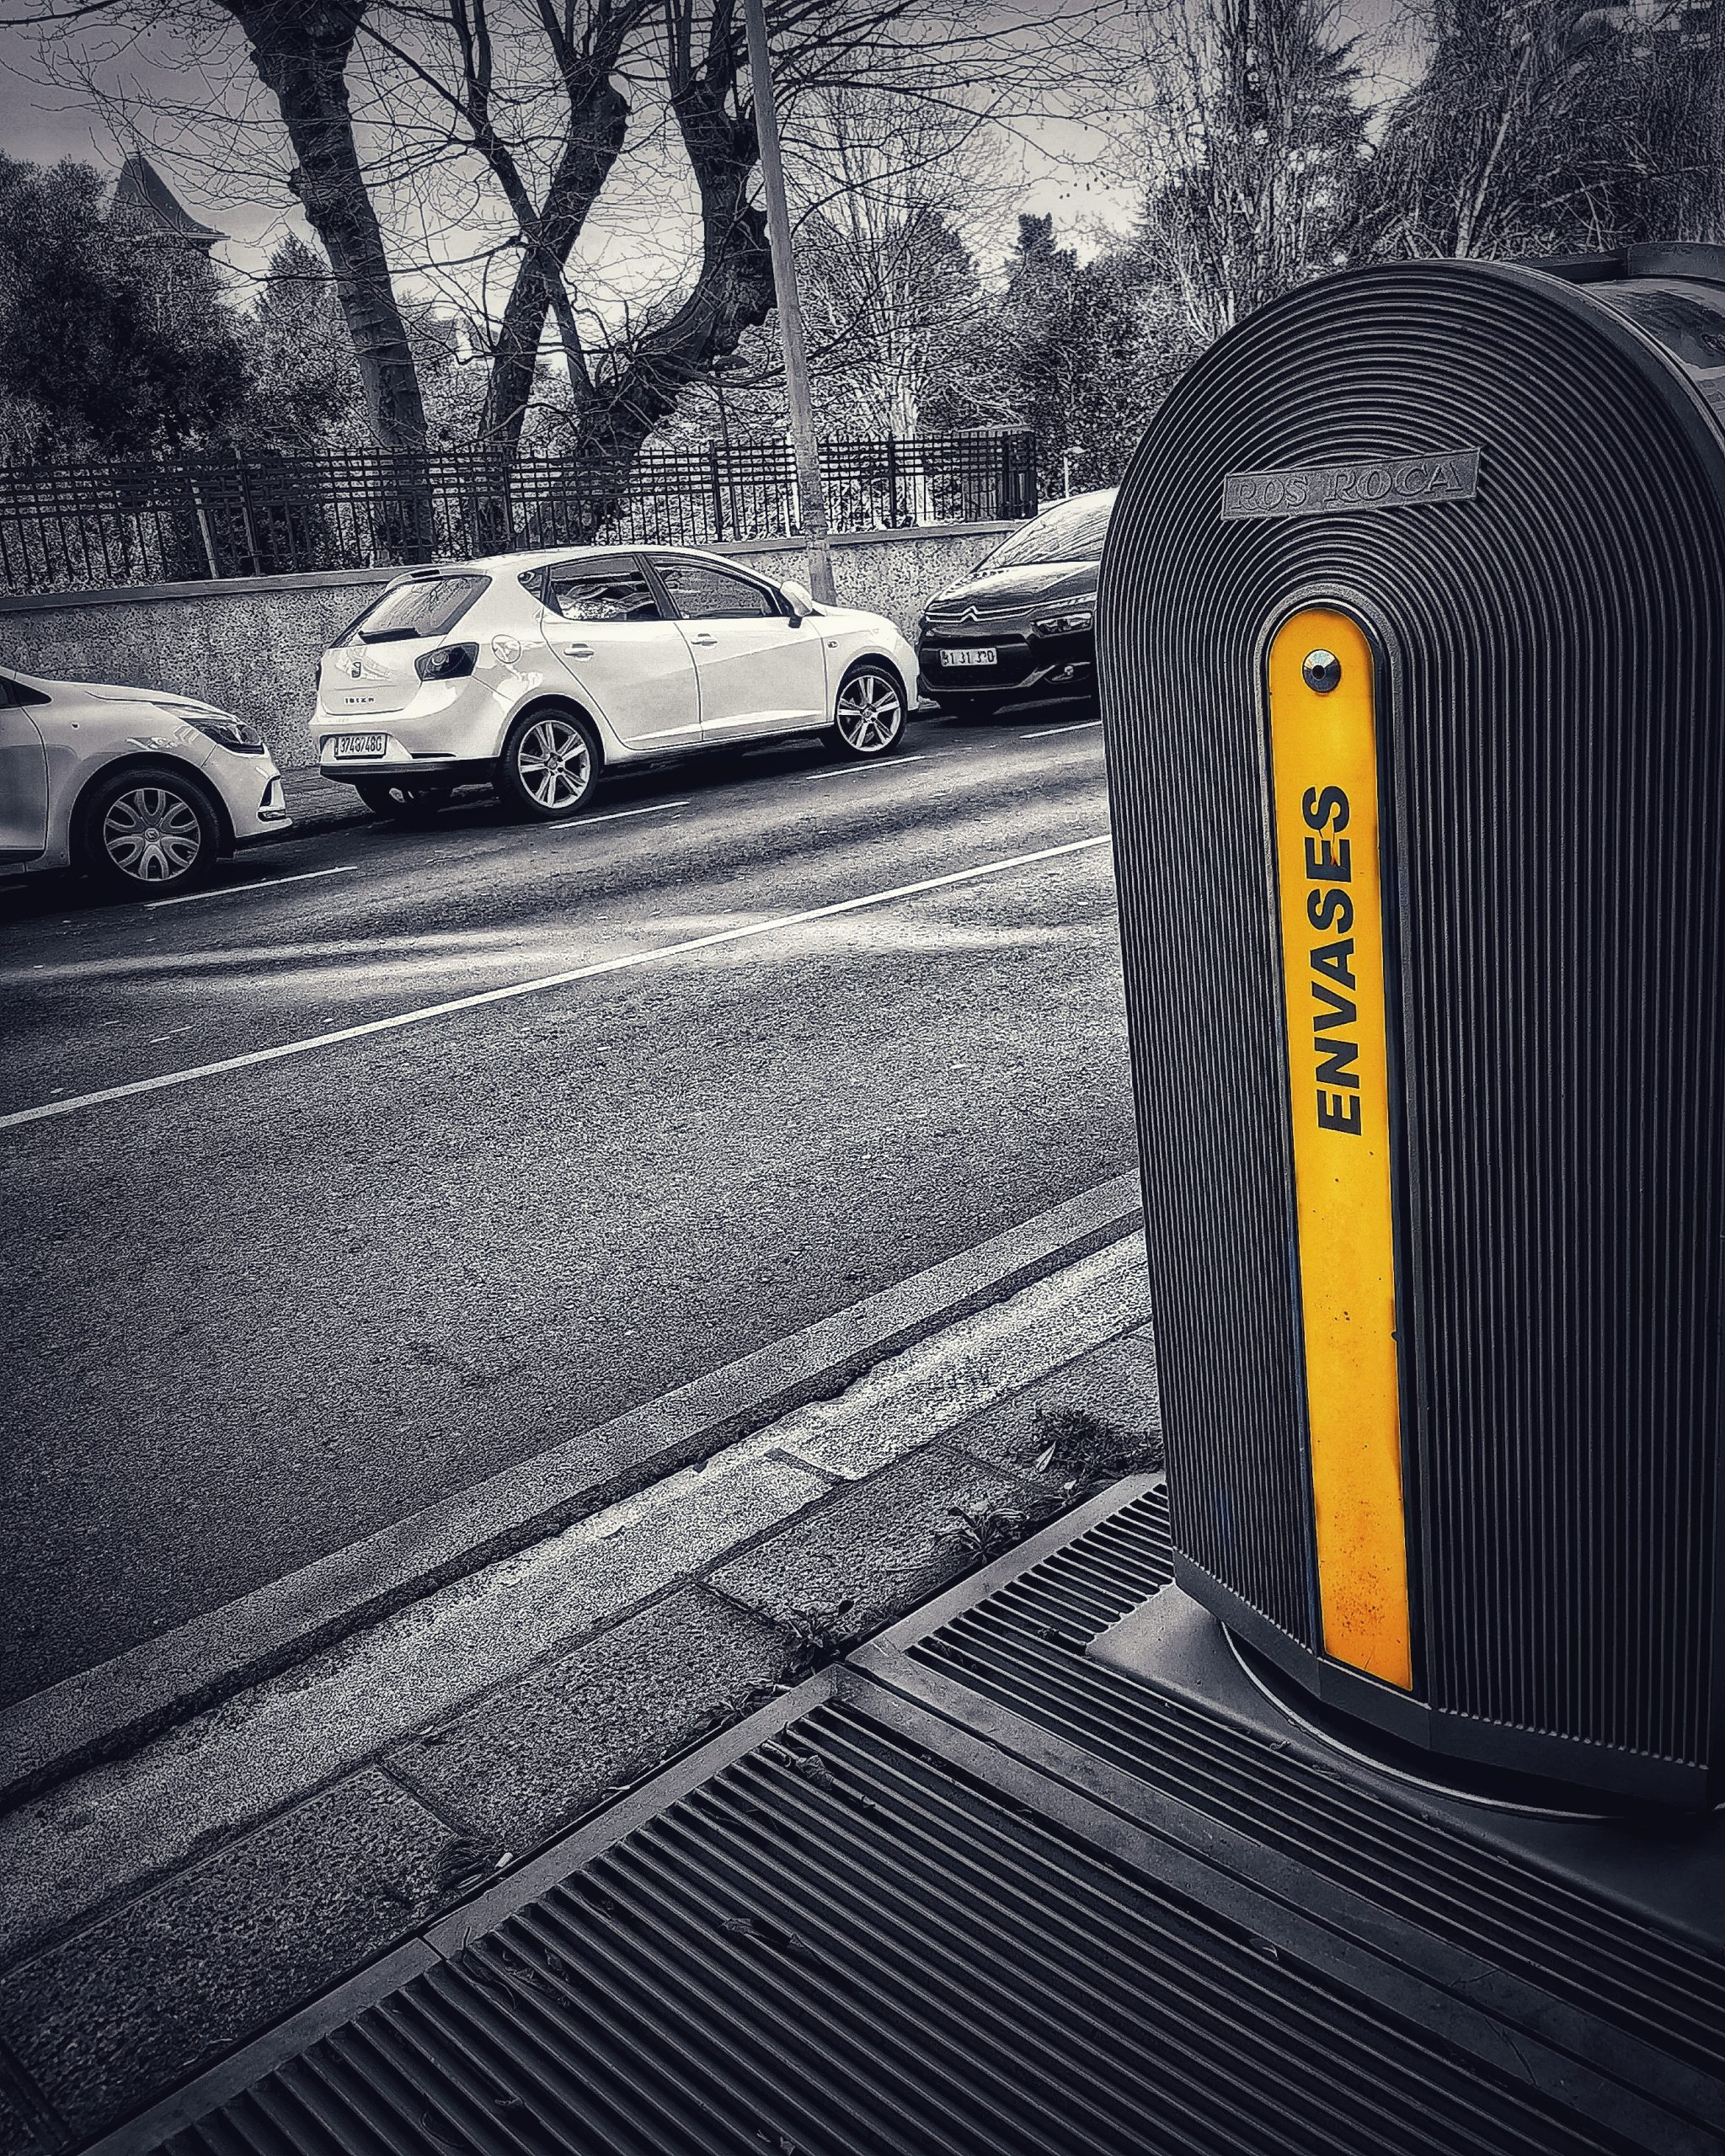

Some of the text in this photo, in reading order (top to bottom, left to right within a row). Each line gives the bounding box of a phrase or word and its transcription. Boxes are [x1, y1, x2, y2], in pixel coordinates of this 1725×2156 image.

[1231, 462, 1465, 511] ROS ROCA
[1302, 785, 1362, 1136] ENVASES
